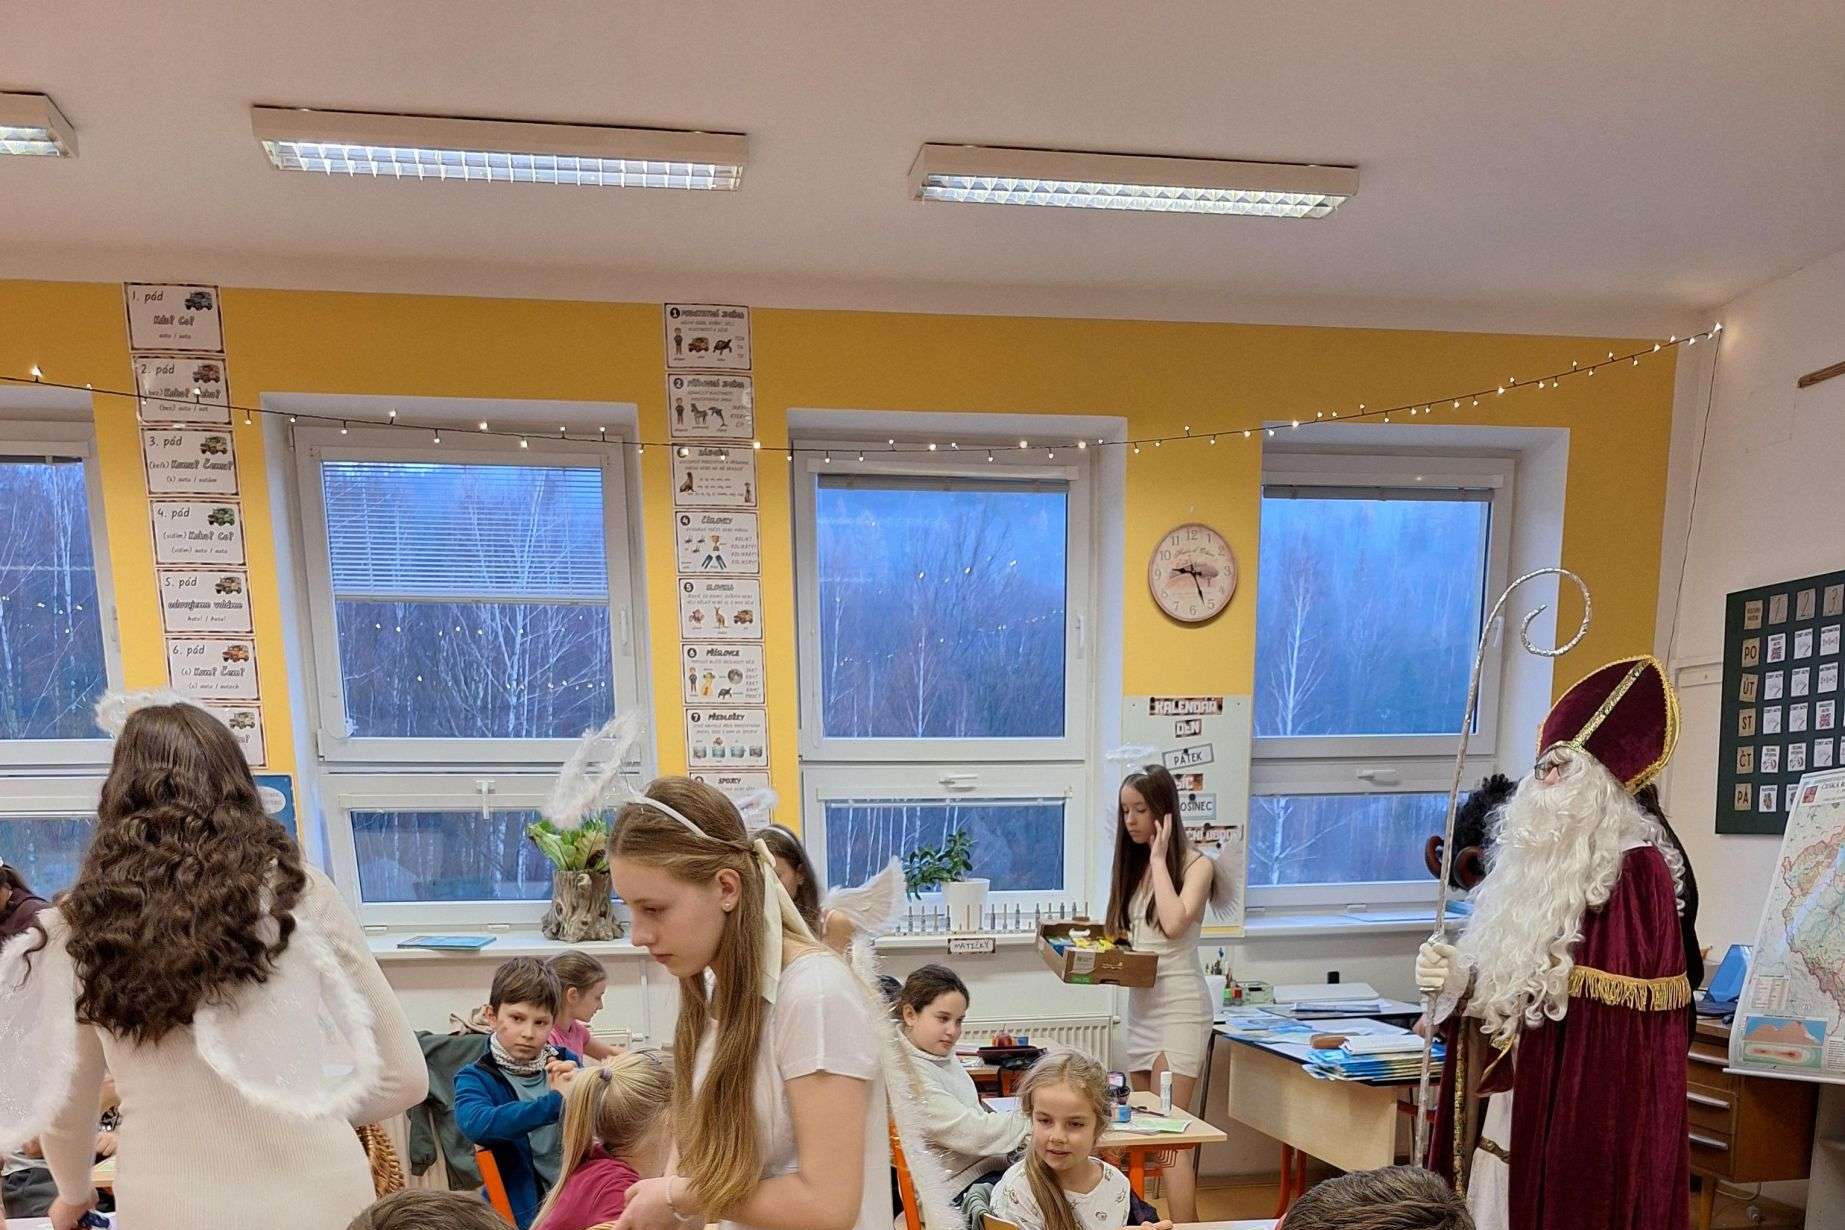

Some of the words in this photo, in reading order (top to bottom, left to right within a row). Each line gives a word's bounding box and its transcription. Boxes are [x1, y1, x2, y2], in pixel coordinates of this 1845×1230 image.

[144, 291, 164, 304] pád
[156, 364, 175, 376] pád
[164, 436, 182, 448] pád
[157, 508, 167, 518] 4.
[172, 508, 190, 519] pád
[1171, 536, 1180, 546] 11
[1186, 530, 1198, 540] 12
[1160, 550, 1172, 560] 10
[1154, 569, 1162, 580] 9
[178, 576, 198, 588] pád
[1174, 602, 1180, 612] 7
[1208, 598, 1215, 610] 5
[1189, 605, 1197, 616] 6
[172, 645, 182, 654] 6.
[186, 645, 205, 656] pád
[1744, 645, 1758, 661] PO
[1744, 677, 1754, 696] ÚT
[1742, 715, 1752, 730] ST
[1740, 750, 1751, 767] ČT
[1737, 785, 1749, 804] PÁ
